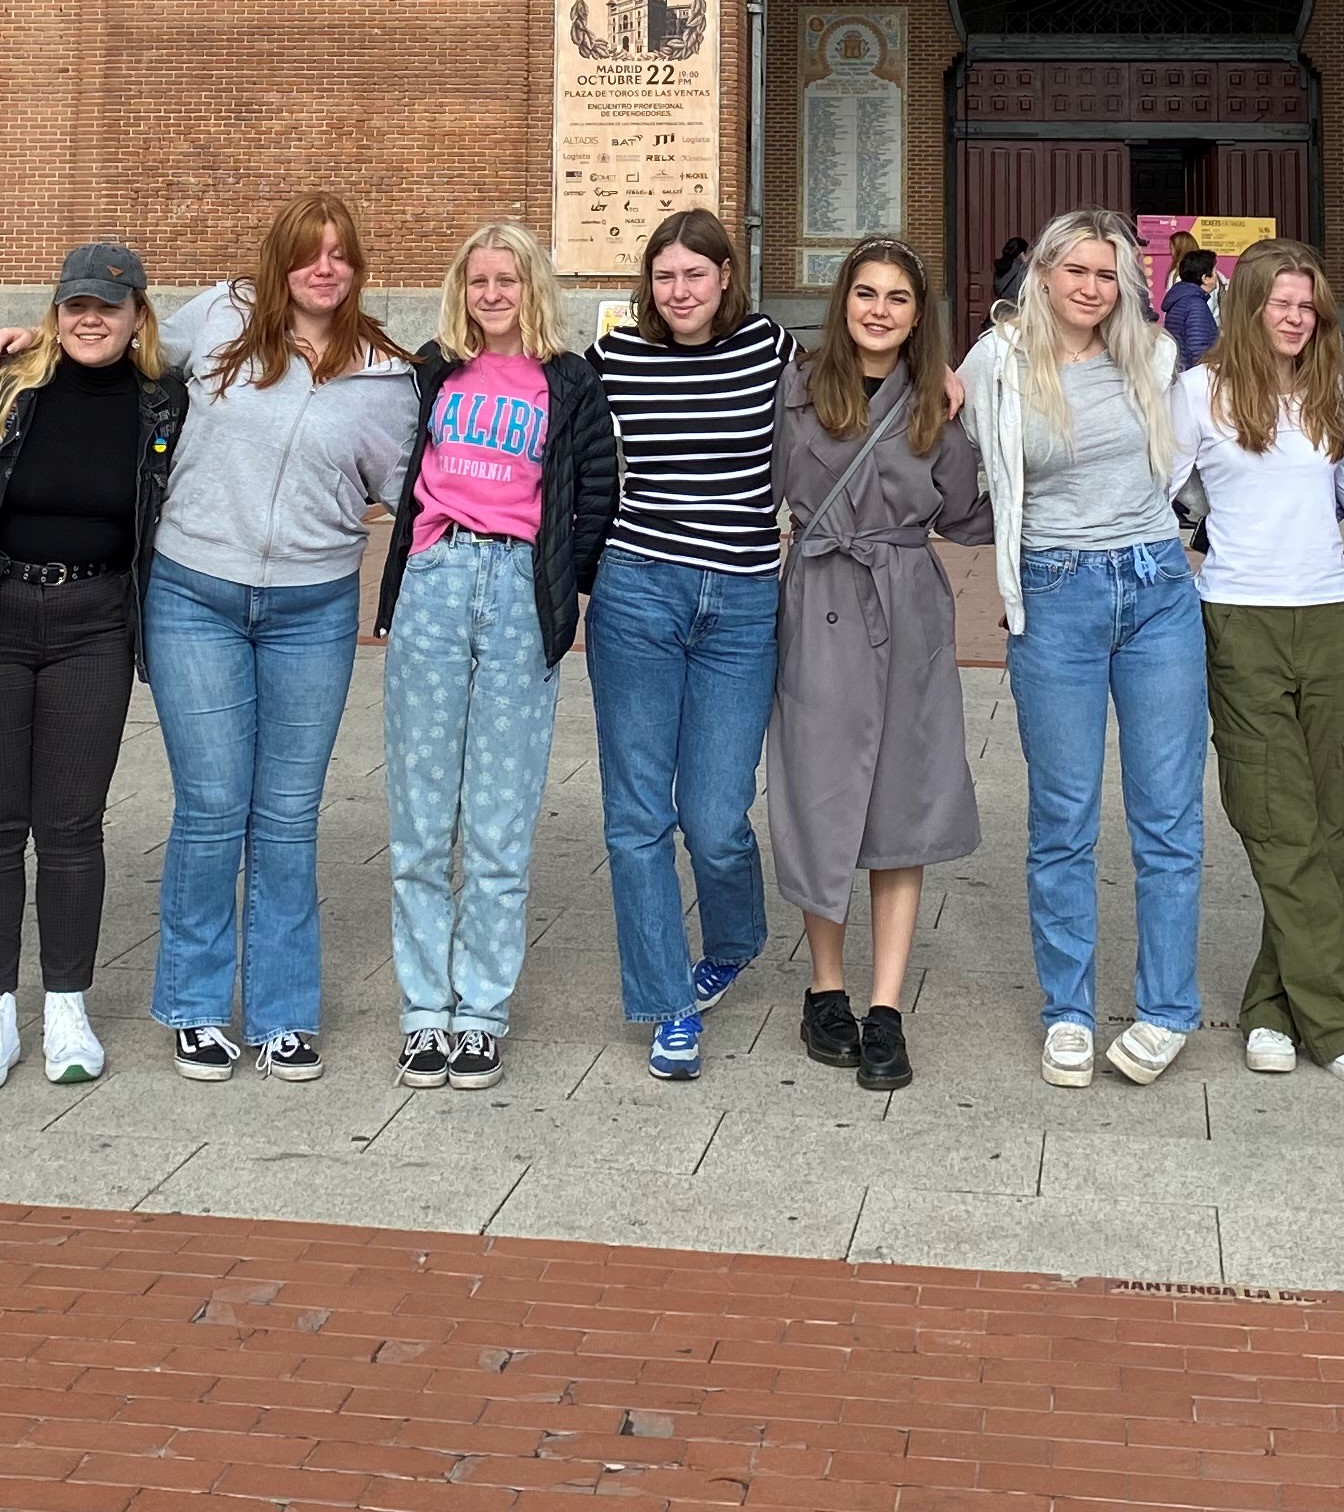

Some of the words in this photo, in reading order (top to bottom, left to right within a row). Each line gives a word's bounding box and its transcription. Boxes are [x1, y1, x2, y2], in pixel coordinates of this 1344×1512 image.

[596, 65, 642, 73] MADRID
[646, 64, 675, 85] 22
[577, 76, 642, 85] OCTUBRE
[439, 455, 512, 482] CALIFORNIA
[1244, 1289, 1271, 1299] LA
